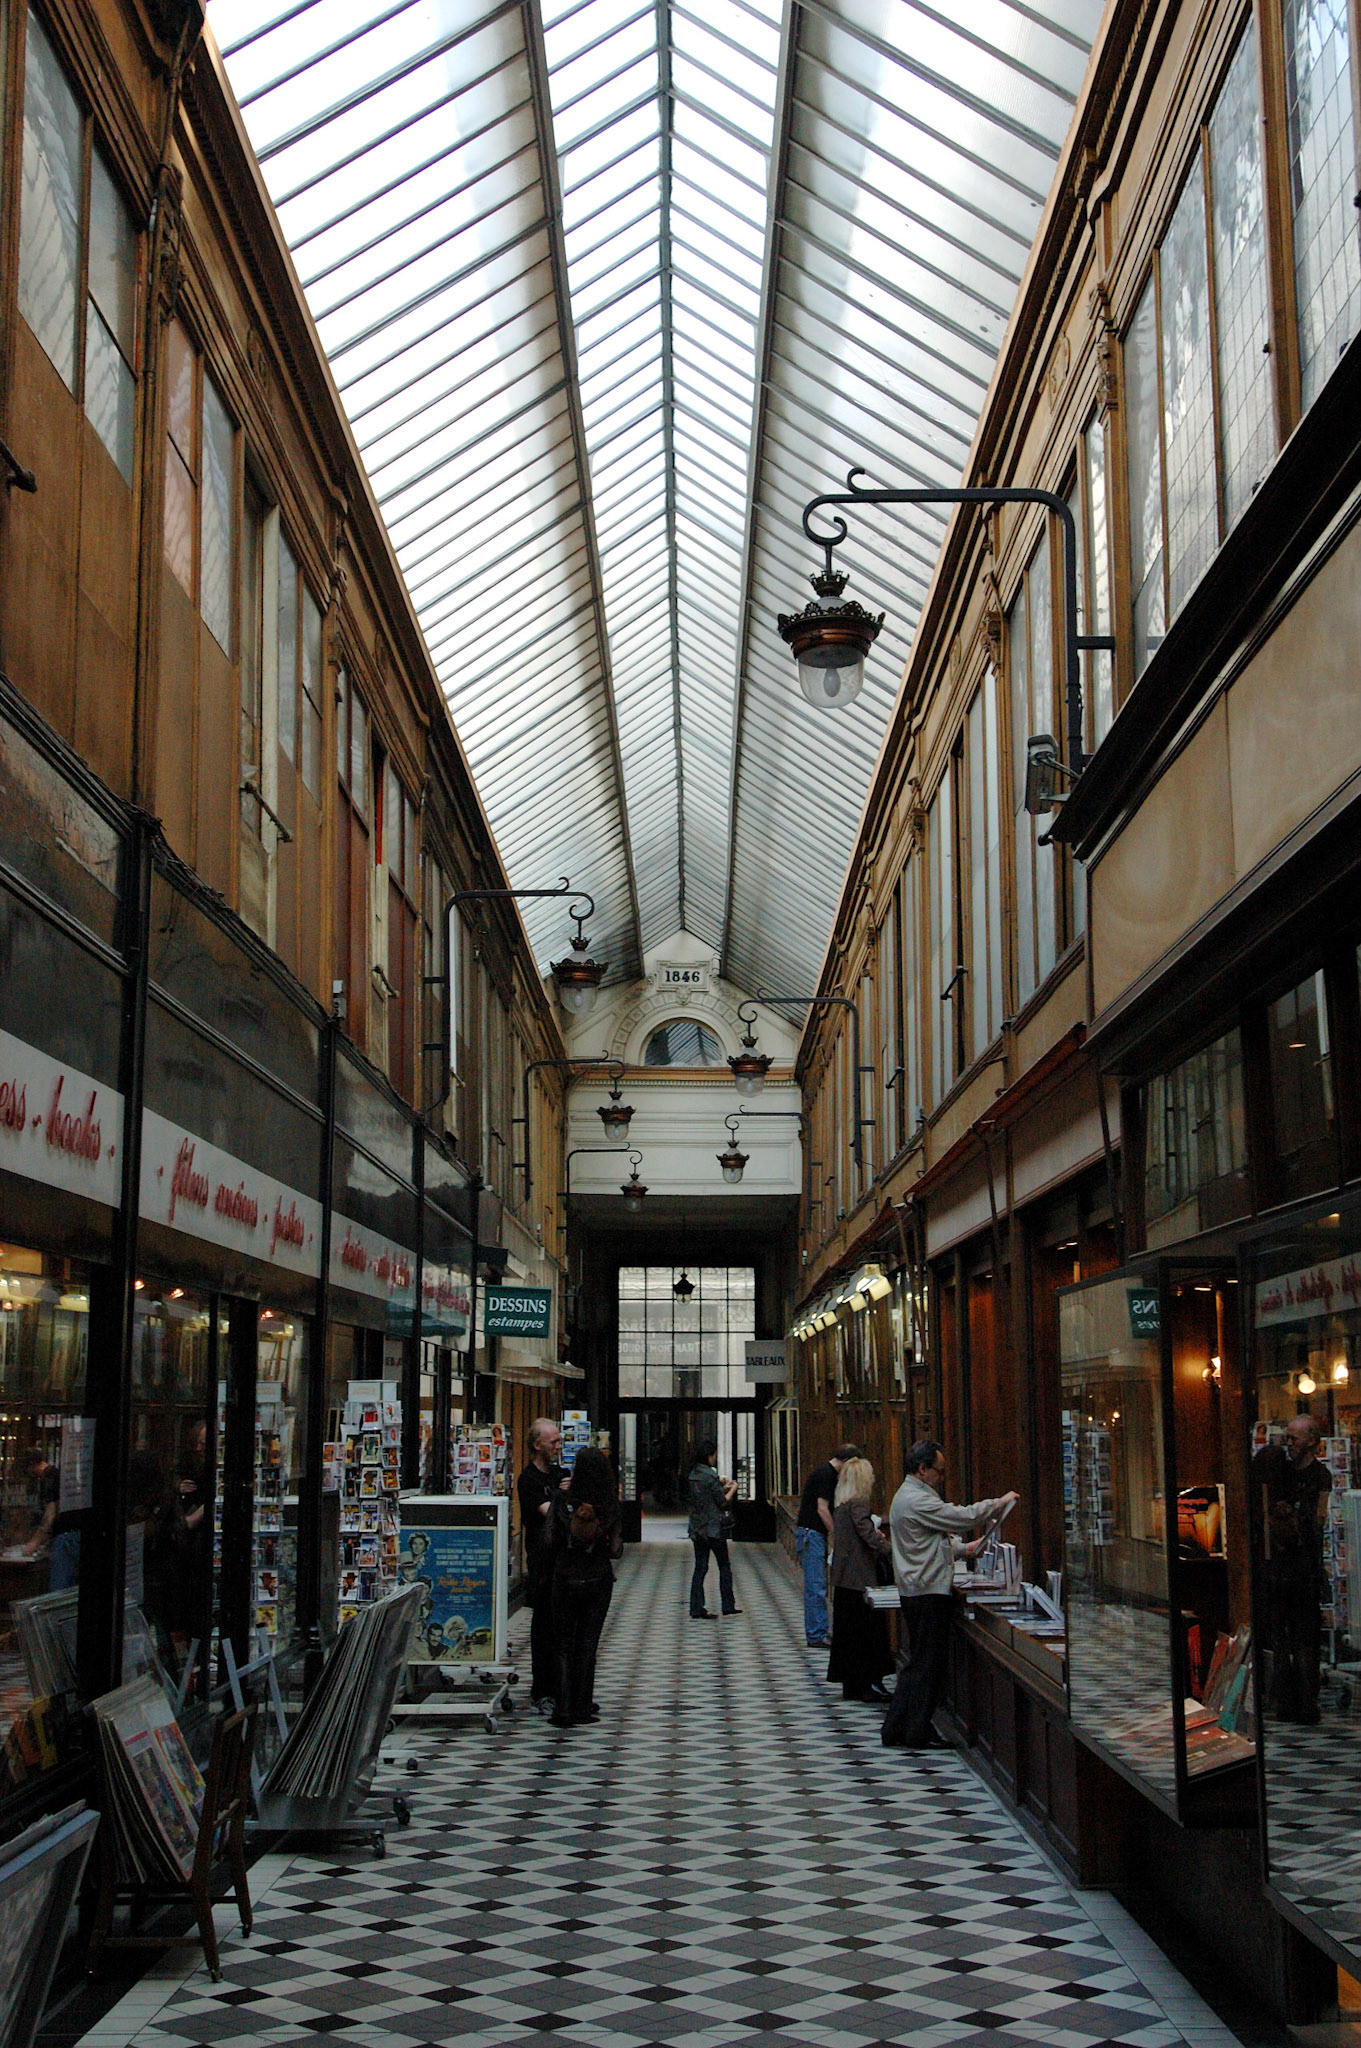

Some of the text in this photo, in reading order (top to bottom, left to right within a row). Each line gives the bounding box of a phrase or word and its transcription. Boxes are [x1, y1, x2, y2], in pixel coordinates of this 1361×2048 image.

[665, 970, 701, 983] 1846
[45, 1075, 101, 1160] books
[168, 1137, 209, 1221] films
[488, 1296, 547, 1314] DESSINS
[488, 1316, 545, 1331] estampes
[649, 1340, 714, 1354] MONMARTRE
[746, 1356, 786, 1366] TABLEAUX
